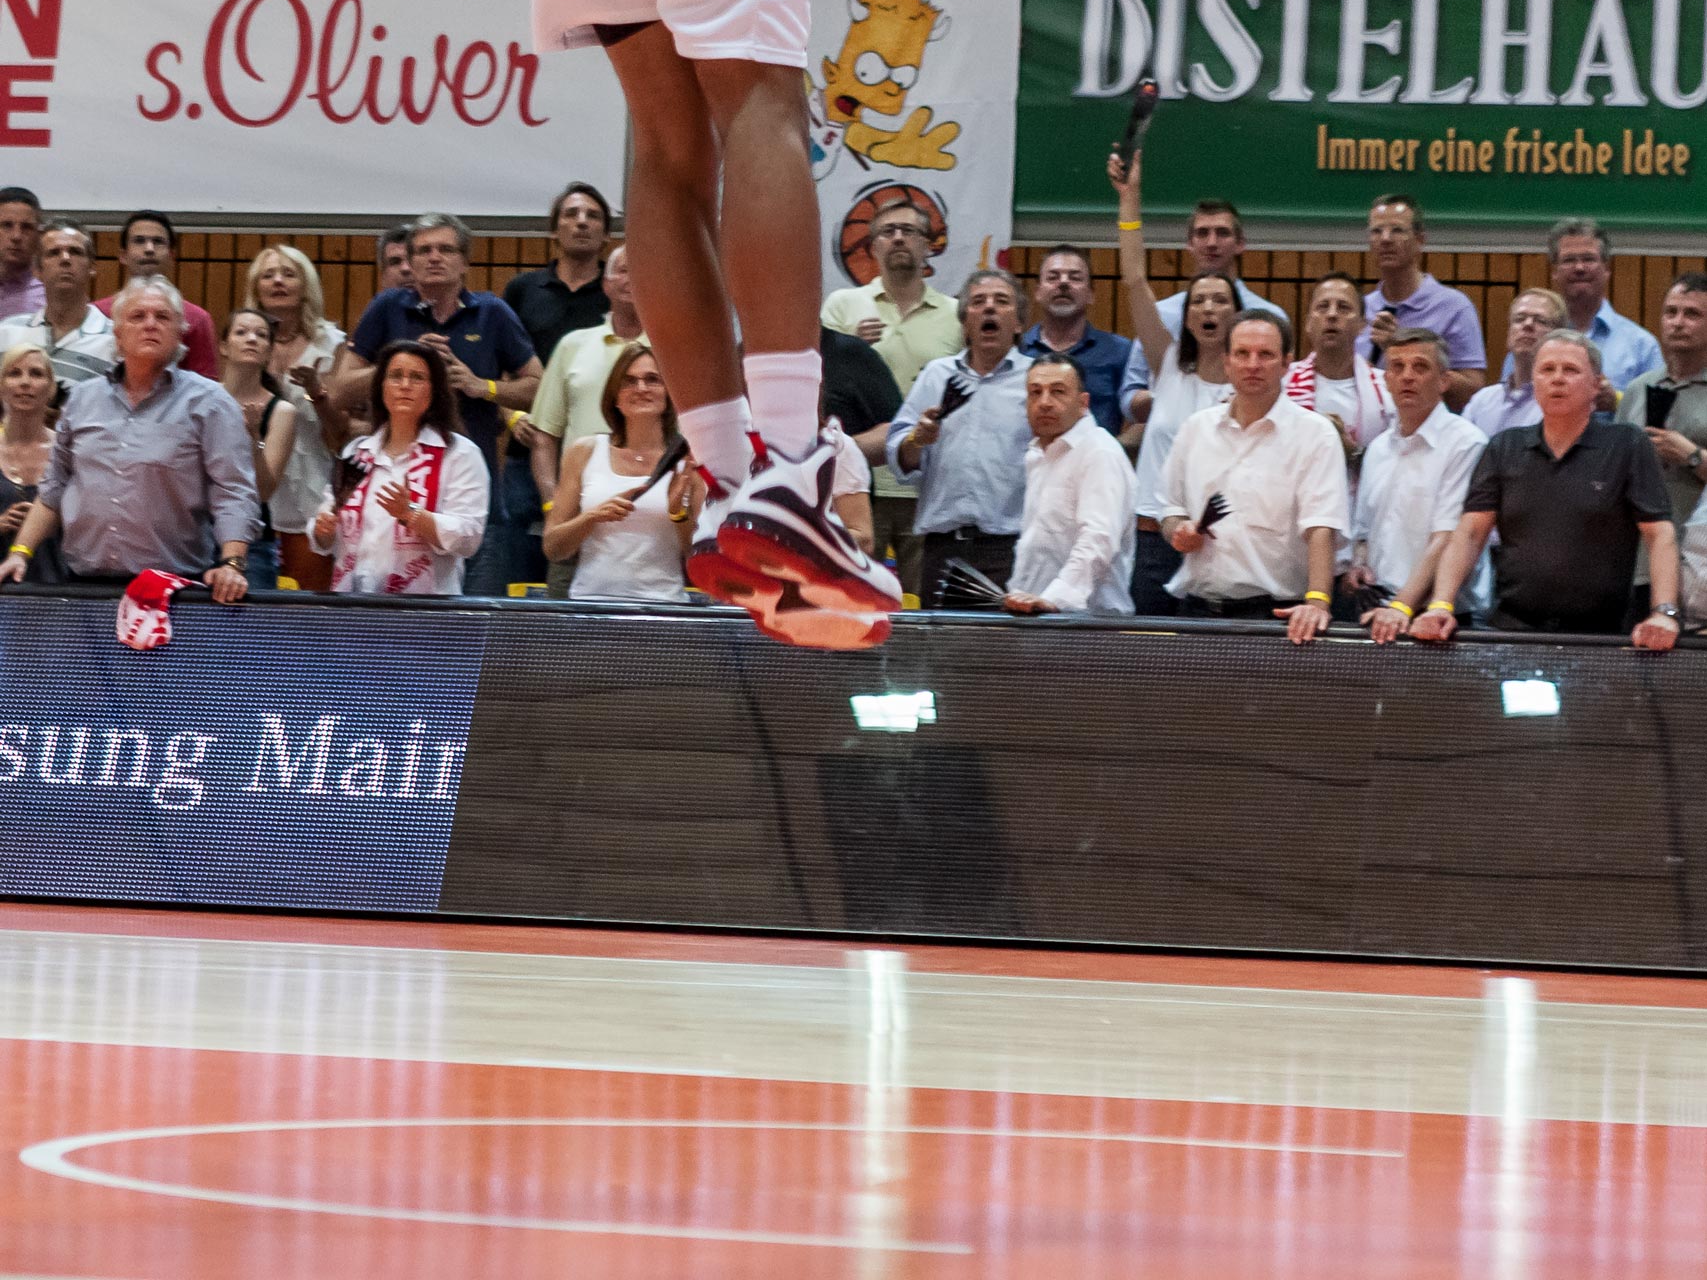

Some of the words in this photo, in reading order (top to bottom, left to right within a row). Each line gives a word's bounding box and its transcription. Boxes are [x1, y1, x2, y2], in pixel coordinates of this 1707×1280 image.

[1316, 124, 1419, 172] Immer
[1428, 127, 1495, 173] eine
[1503, 126, 1613, 176] frische
[1621, 128, 1691, 177] Idee
[0, 723, 218, 811] sung
